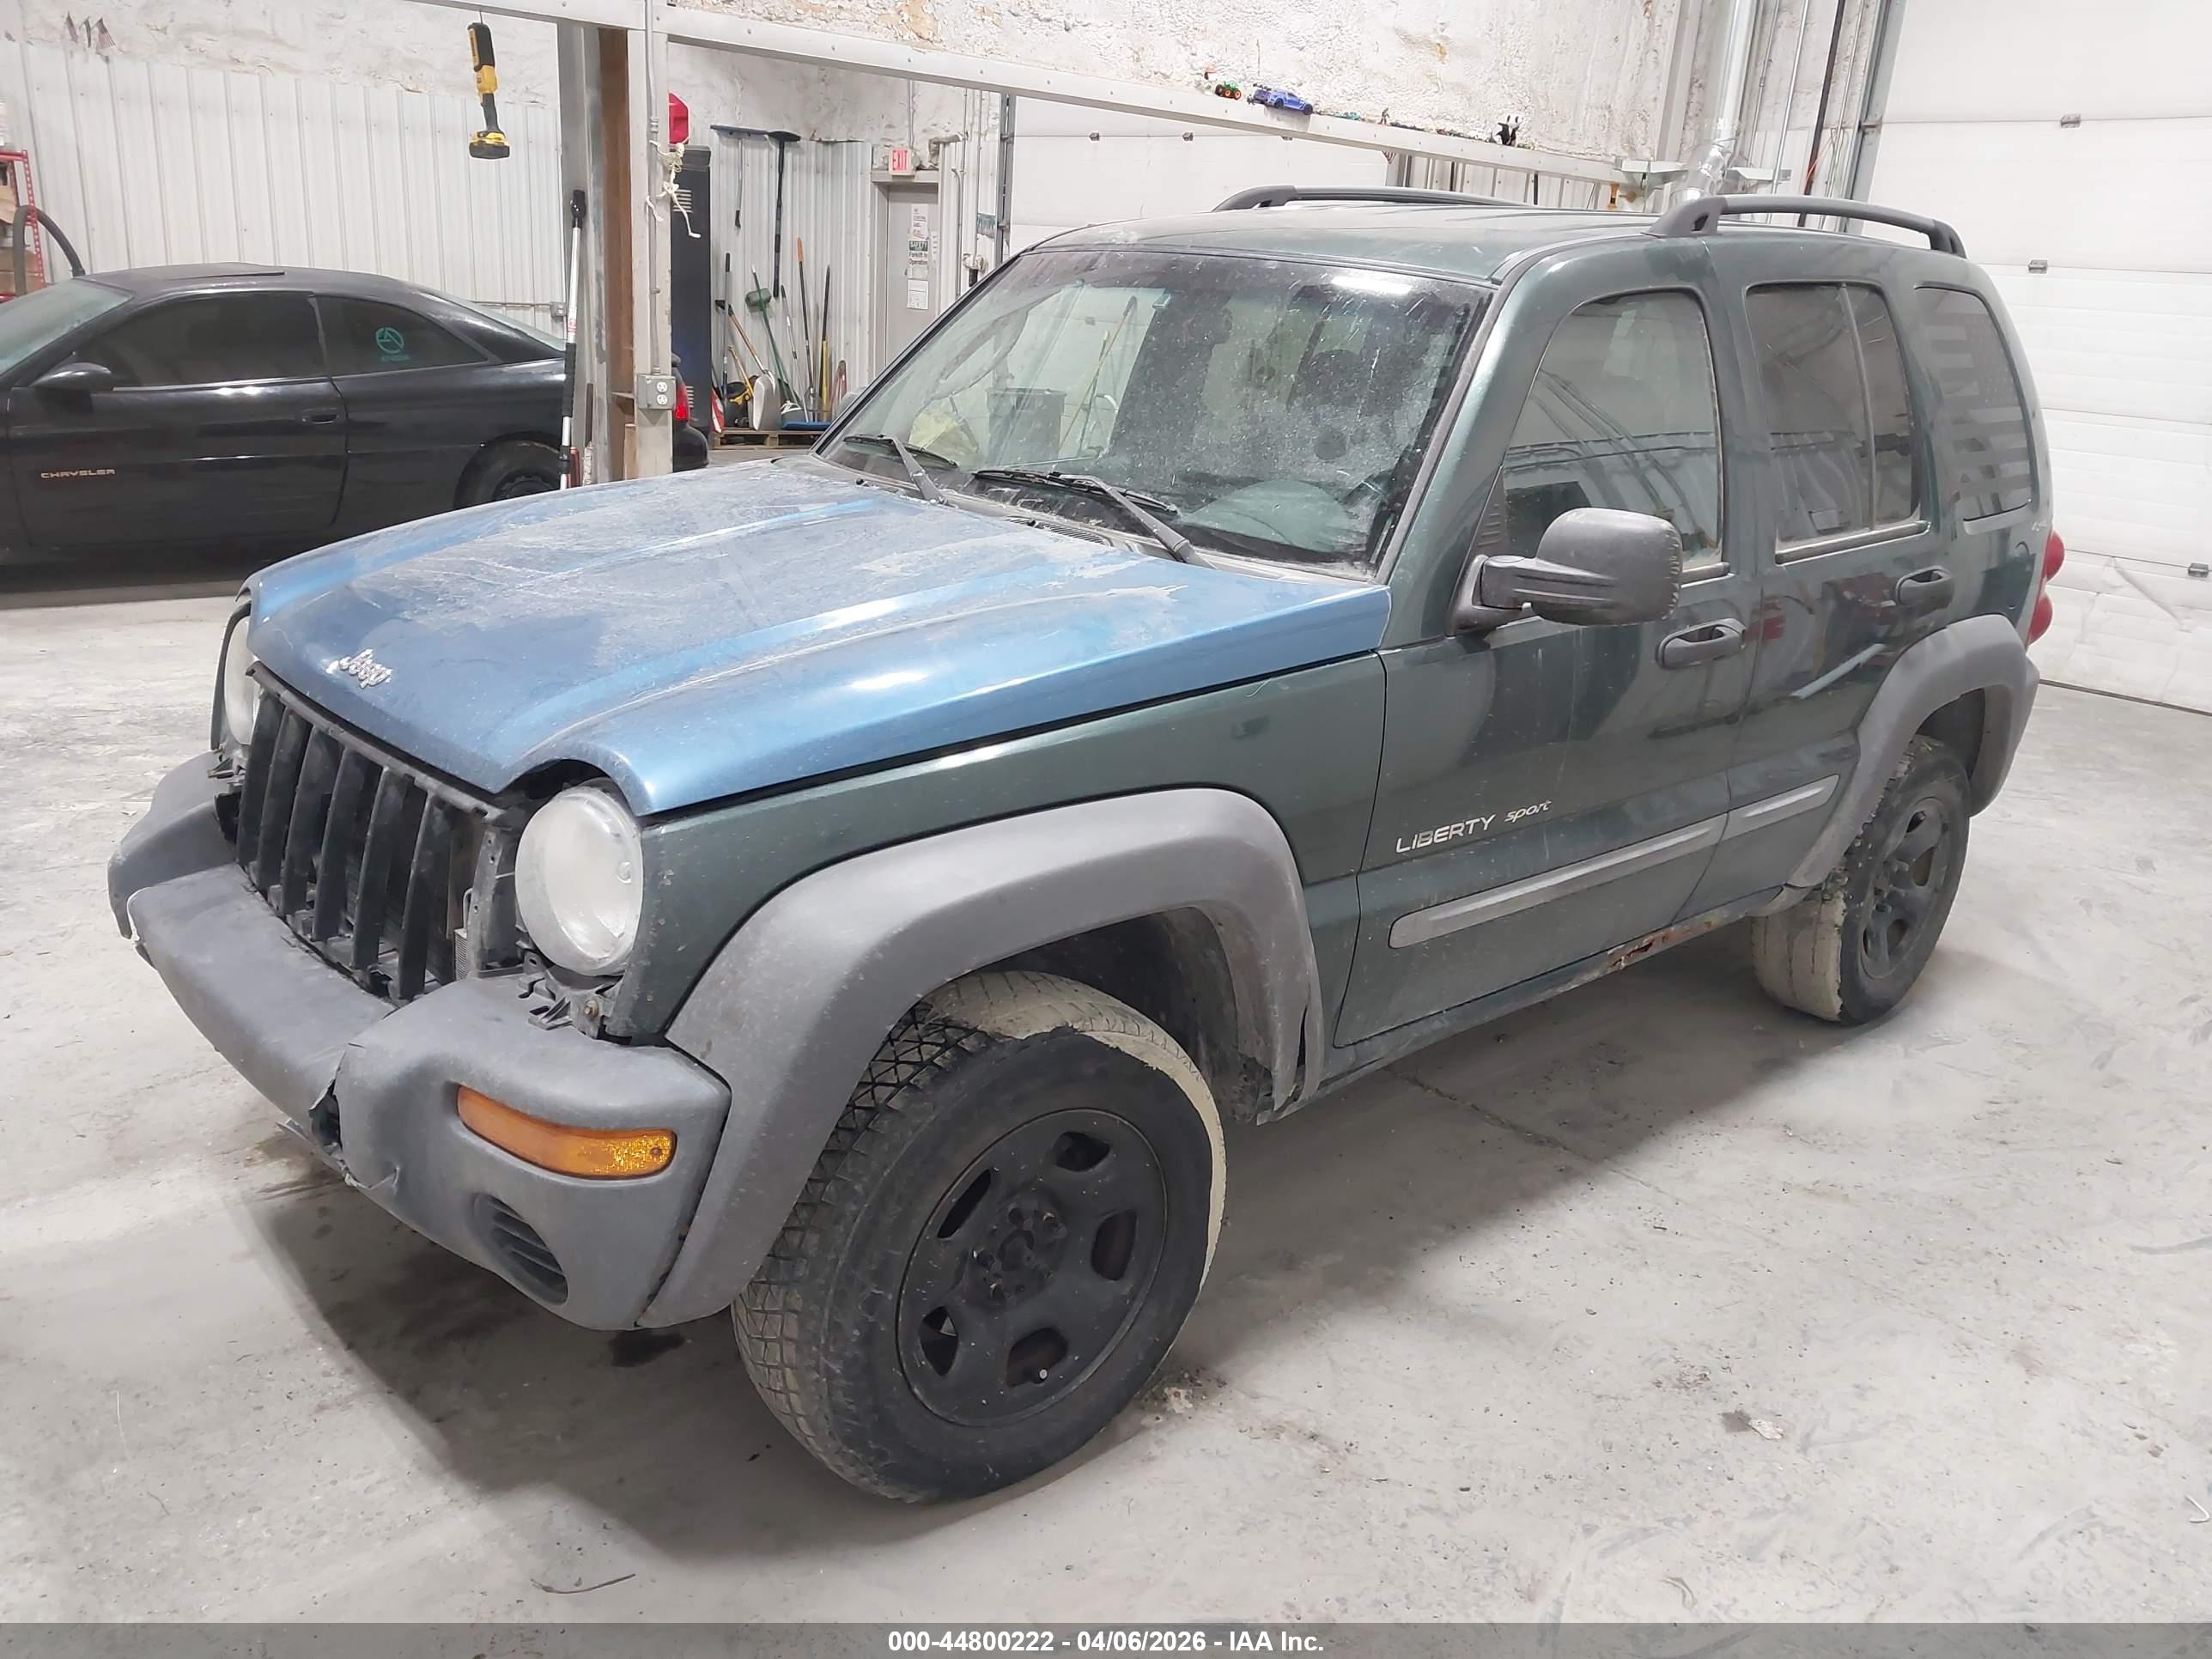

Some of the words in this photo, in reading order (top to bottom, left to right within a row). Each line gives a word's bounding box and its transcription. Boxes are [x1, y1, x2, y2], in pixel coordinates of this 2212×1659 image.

[892, 150, 908, 171] EXIT
[40, 469, 116, 479] CHRYSLER
[1395, 813, 1498, 854] LIBERTY
[1504, 799, 1553, 823] sport
